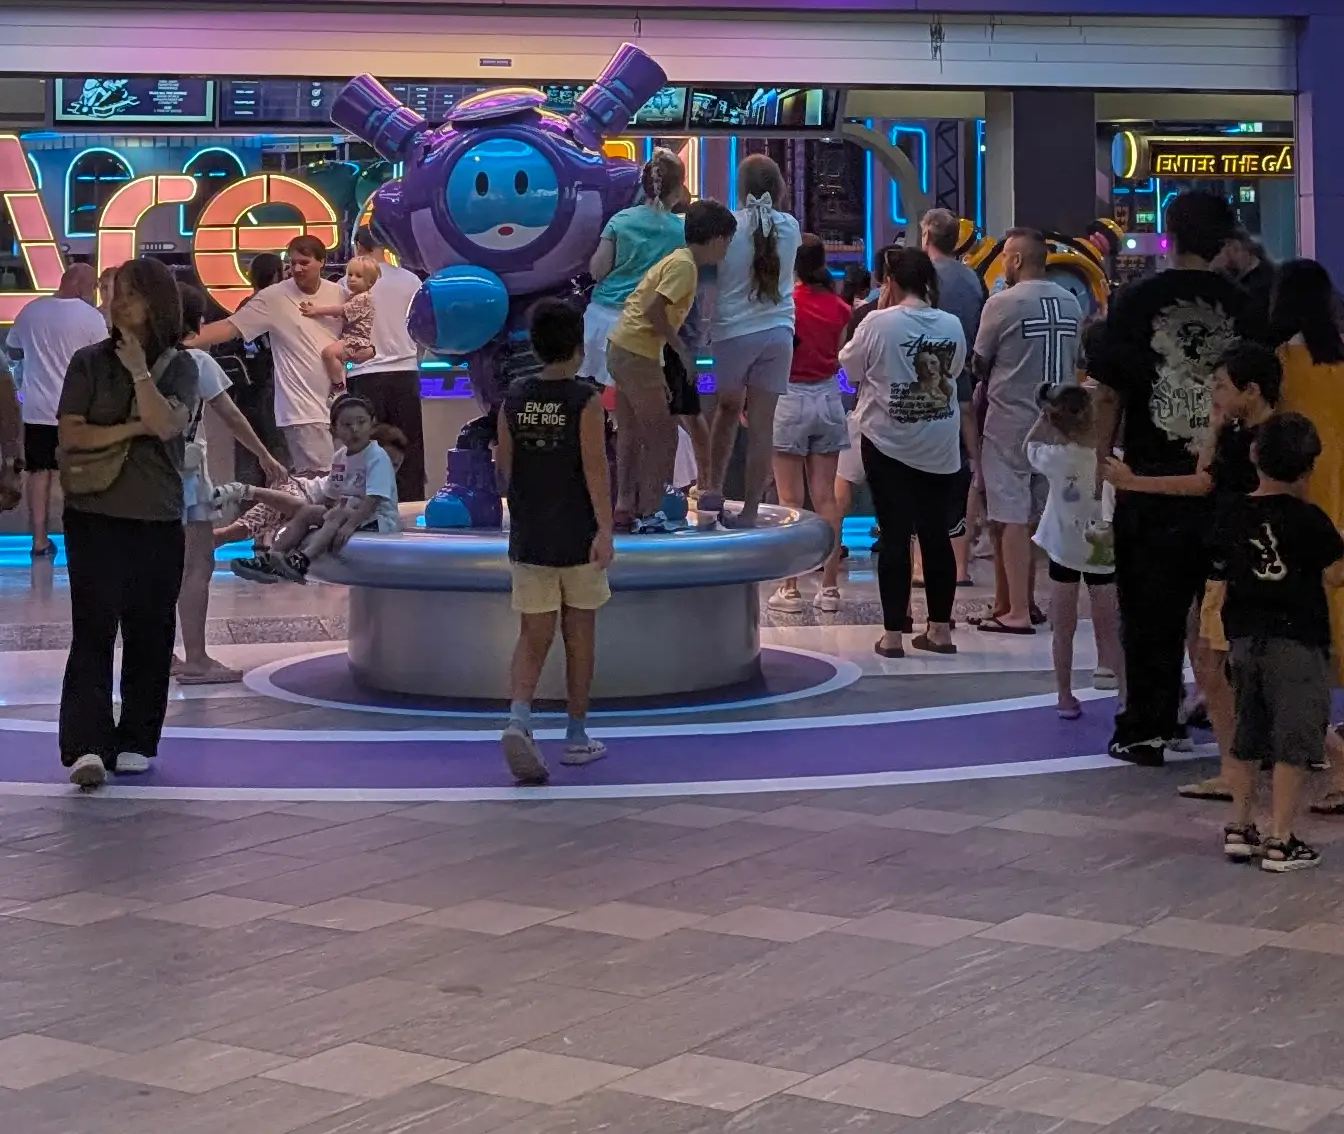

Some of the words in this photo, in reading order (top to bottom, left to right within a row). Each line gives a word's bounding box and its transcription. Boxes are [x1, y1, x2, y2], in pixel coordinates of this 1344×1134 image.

[1156, 155, 1216, 173] ENTER
[1222, 155, 1259, 173] THE
[525, 401, 562, 414] ENJOY
[517, 412, 538, 425] THE
[541, 414, 567, 426] RIDE
